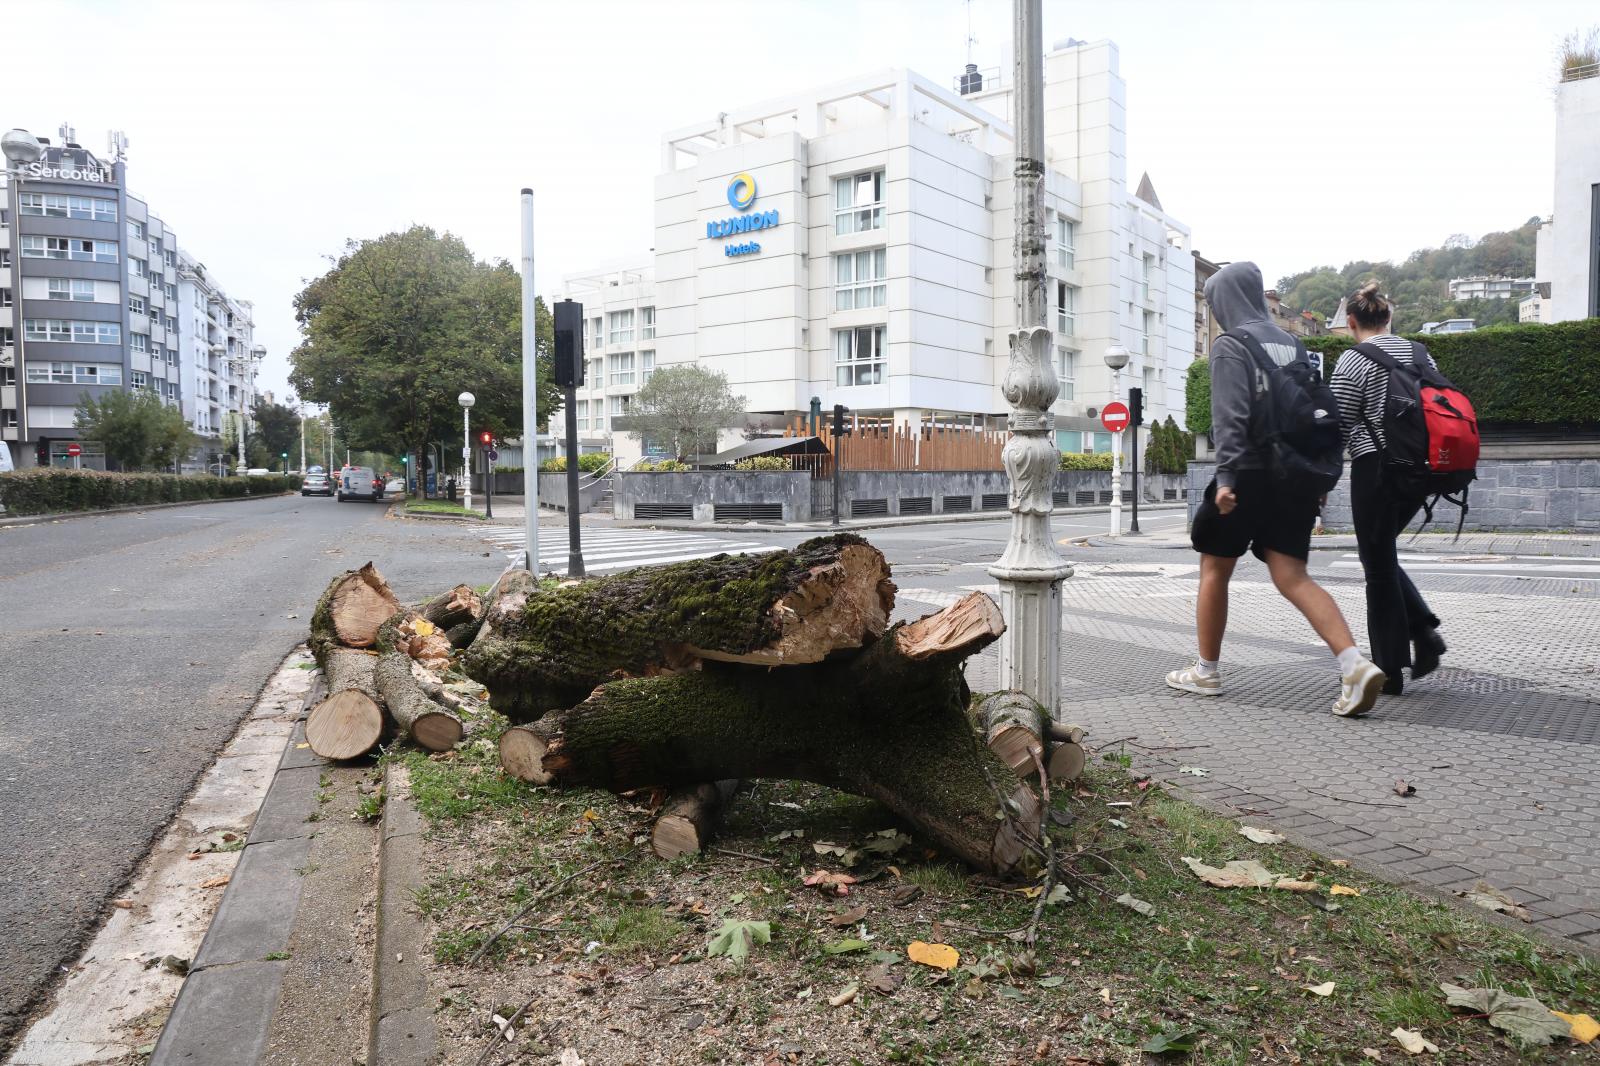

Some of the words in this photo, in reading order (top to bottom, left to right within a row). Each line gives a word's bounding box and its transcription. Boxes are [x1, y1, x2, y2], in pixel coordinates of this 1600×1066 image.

[29, 162, 104, 182] Sercotel
[707, 209, 779, 238] ILUNION
[725, 241, 761, 256] Hotels
